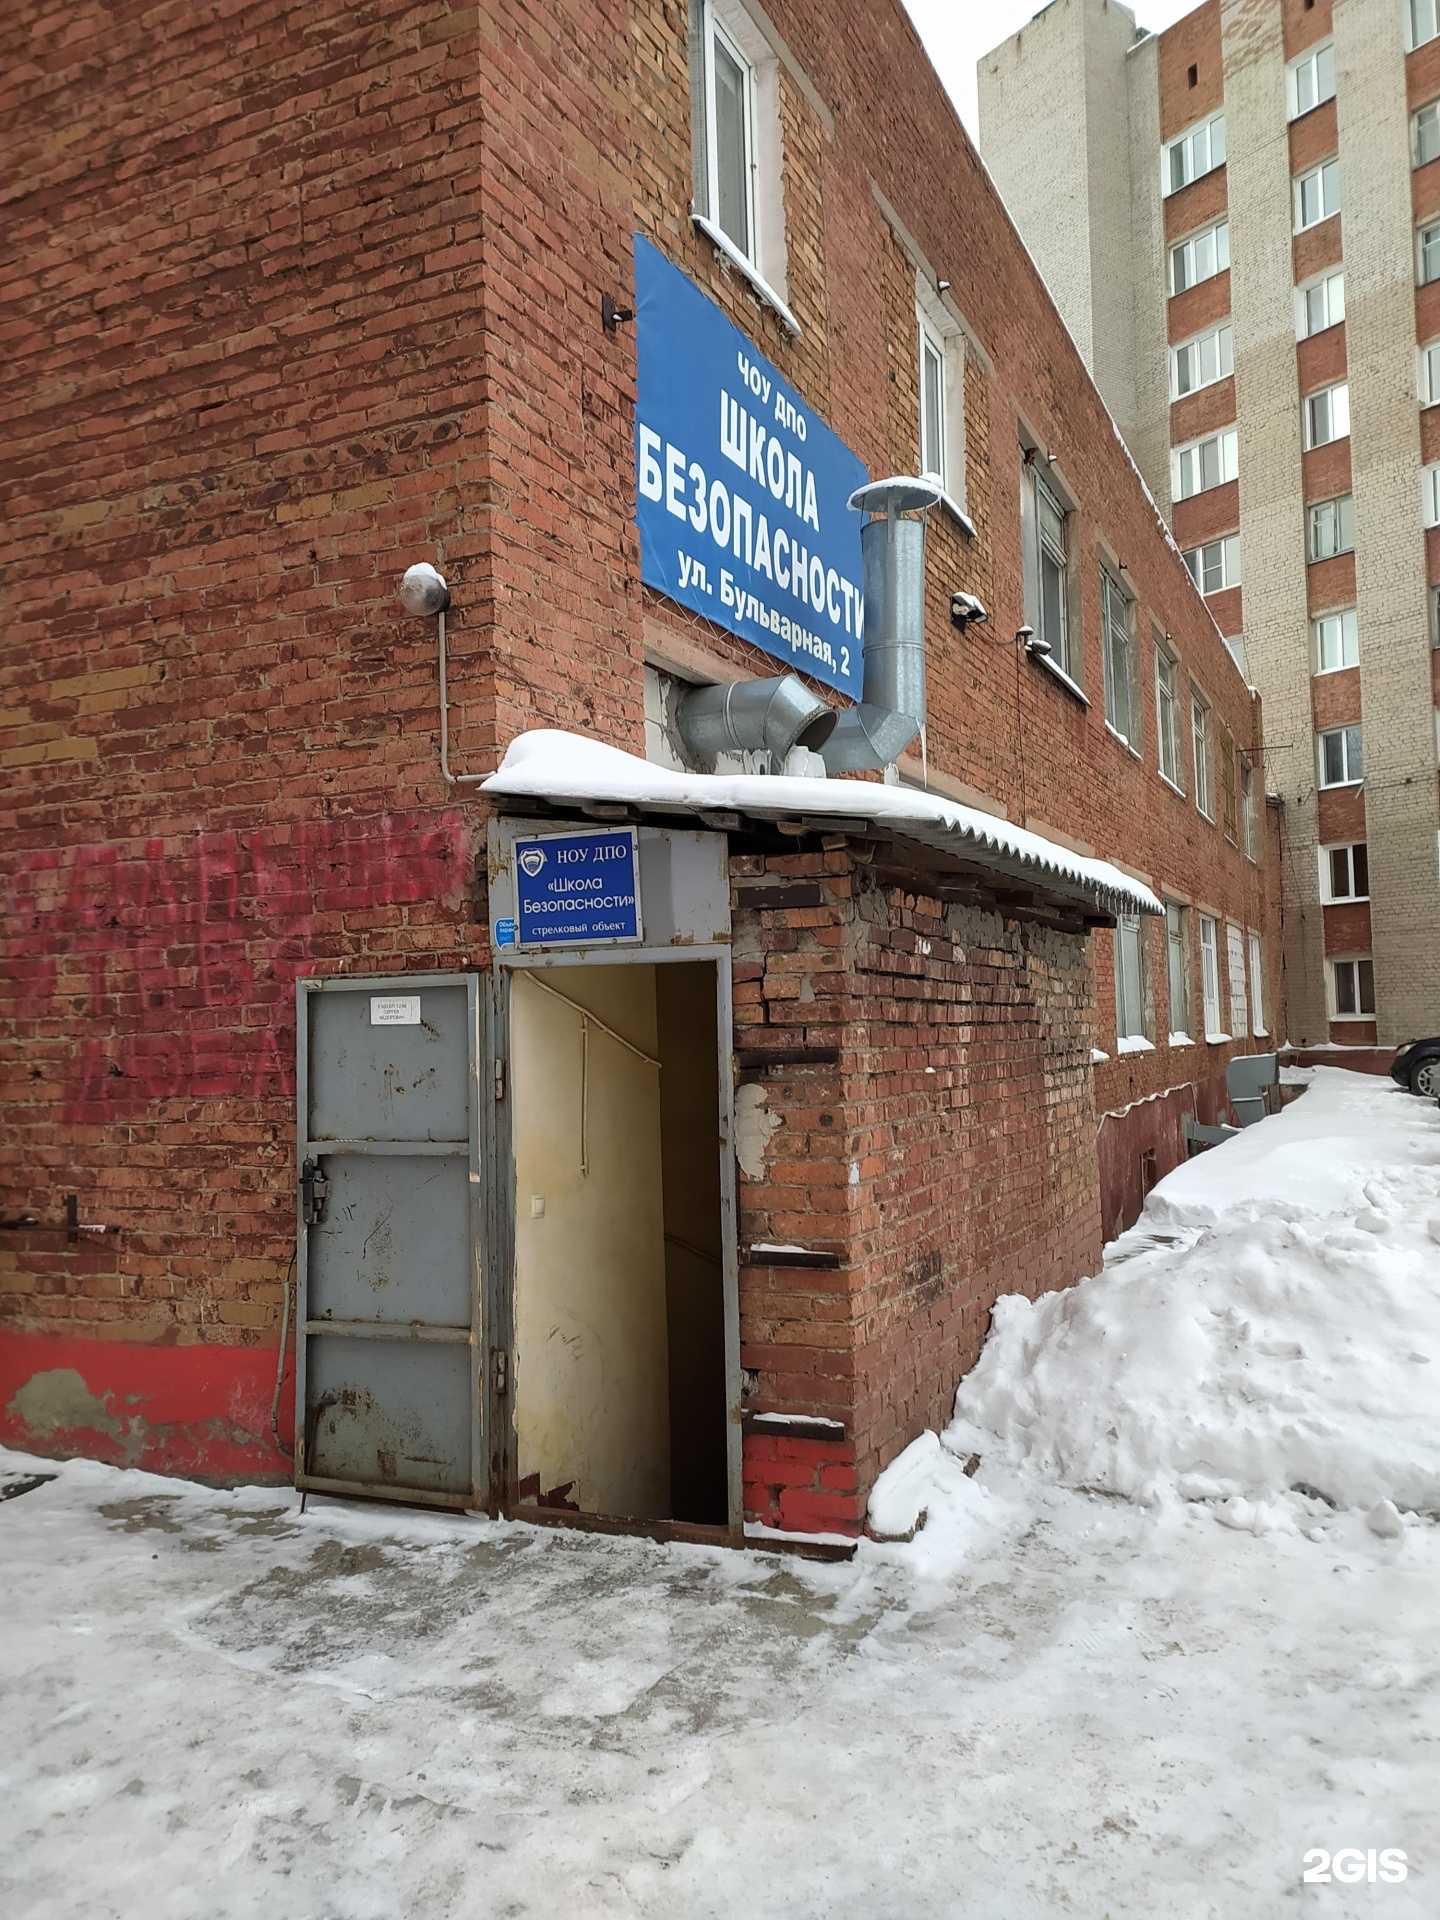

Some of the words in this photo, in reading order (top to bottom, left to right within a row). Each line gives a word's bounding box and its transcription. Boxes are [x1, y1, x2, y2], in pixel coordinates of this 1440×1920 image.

[738, 352, 771, 405] ЧОУ
[775, 391, 807, 442] ДПО
[720, 388, 820, 532] ШКОЛА
[677, 548, 713, 595] ул.
[720, 568, 837, 675] Бульварная,
[841, 645, 850, 678] 2
[557, 848, 589, 864] НОУ
[593, 845, 627, 863] ДПО
[547, 877, 603, 893] «Школа
[523, 896, 635, 914] Безопасности»
[531, 923, 588, 937] стрелковый
[592, 921, 626, 932] объект
